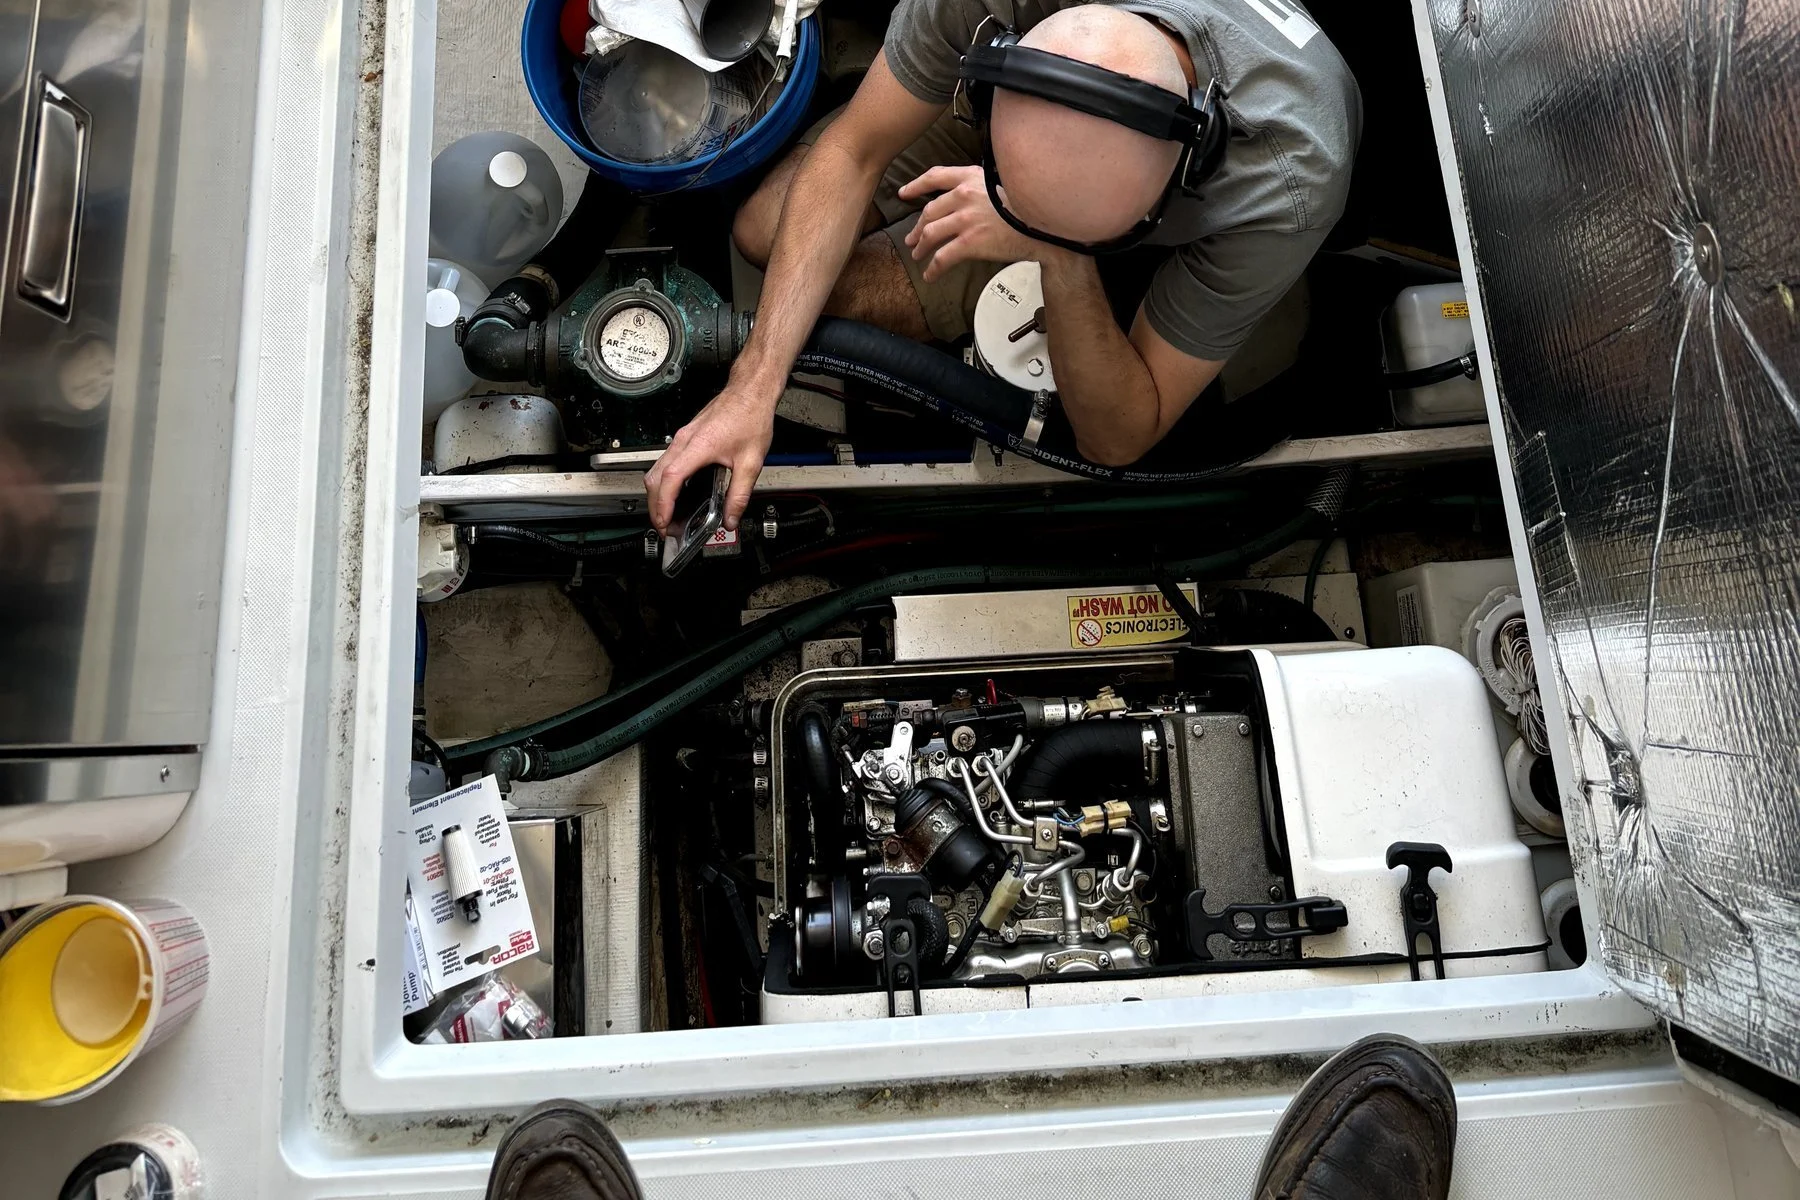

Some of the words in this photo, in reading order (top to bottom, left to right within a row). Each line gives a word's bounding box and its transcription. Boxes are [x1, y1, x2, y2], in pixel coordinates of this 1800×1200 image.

[823, 357, 849, 367] EXHAUST
[854, 366, 874, 374] WATER
[1126, 594, 1158, 614] NOT
[439, 781, 482, 803] Replacement
[411, 799, 439, 815] Element
[478, 855, 511, 873] 025-RAC-02
[425, 869, 444, 881] S2501
[482, 867, 514, 884] 025-RAC-01
[484, 887, 497, 896] Fuel
[497, 879, 516, 890] In-line
[495, 888, 512, 898] Racor
[495, 895, 508, 904] use
[507, 891, 518, 900] For
